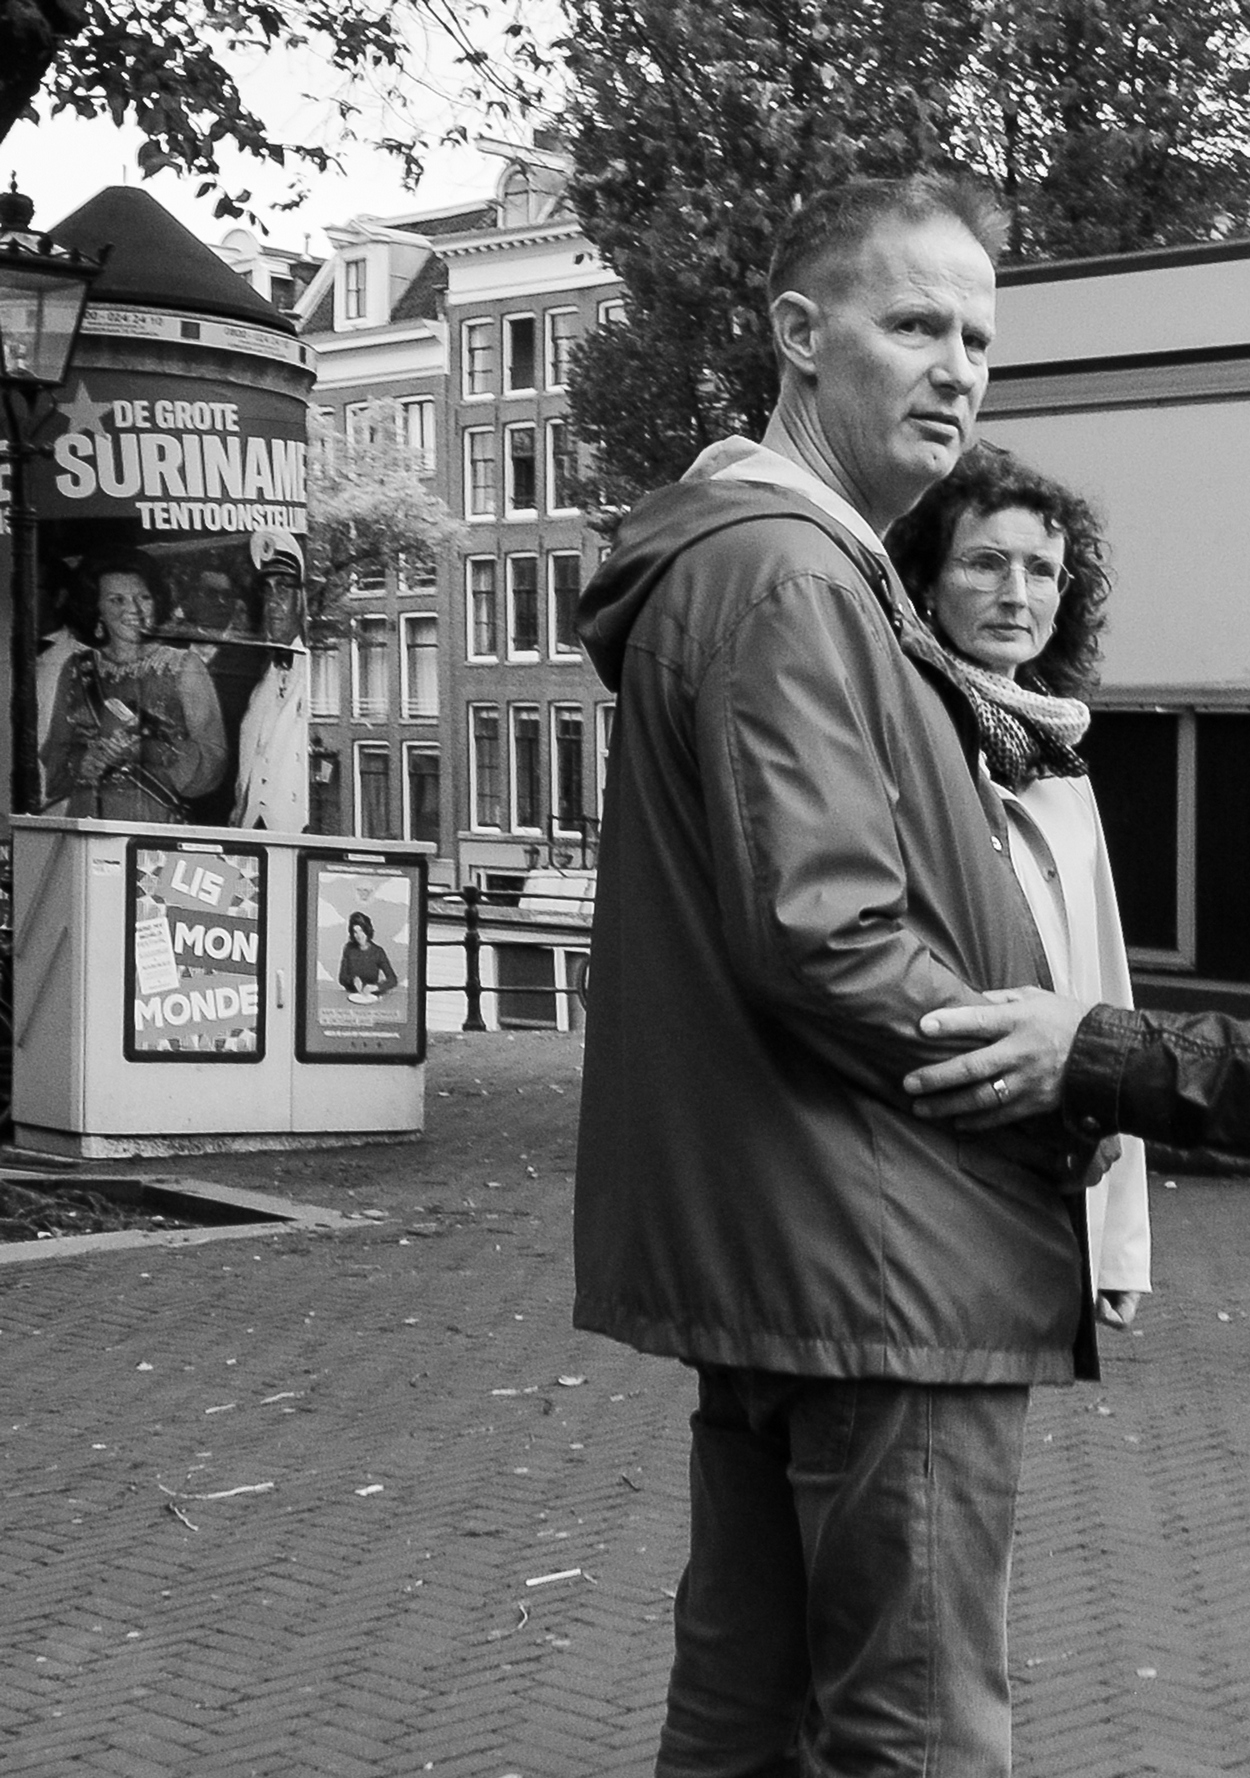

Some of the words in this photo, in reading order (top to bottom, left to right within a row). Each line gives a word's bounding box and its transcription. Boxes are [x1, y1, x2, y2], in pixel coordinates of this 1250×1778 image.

[113, 400, 152, 429] DE
[154, 401, 240, 432] GROTE
[171, 859, 225, 907] LIS
[174, 921, 259, 964] MON
[134, 983, 259, 1031] MONDE
